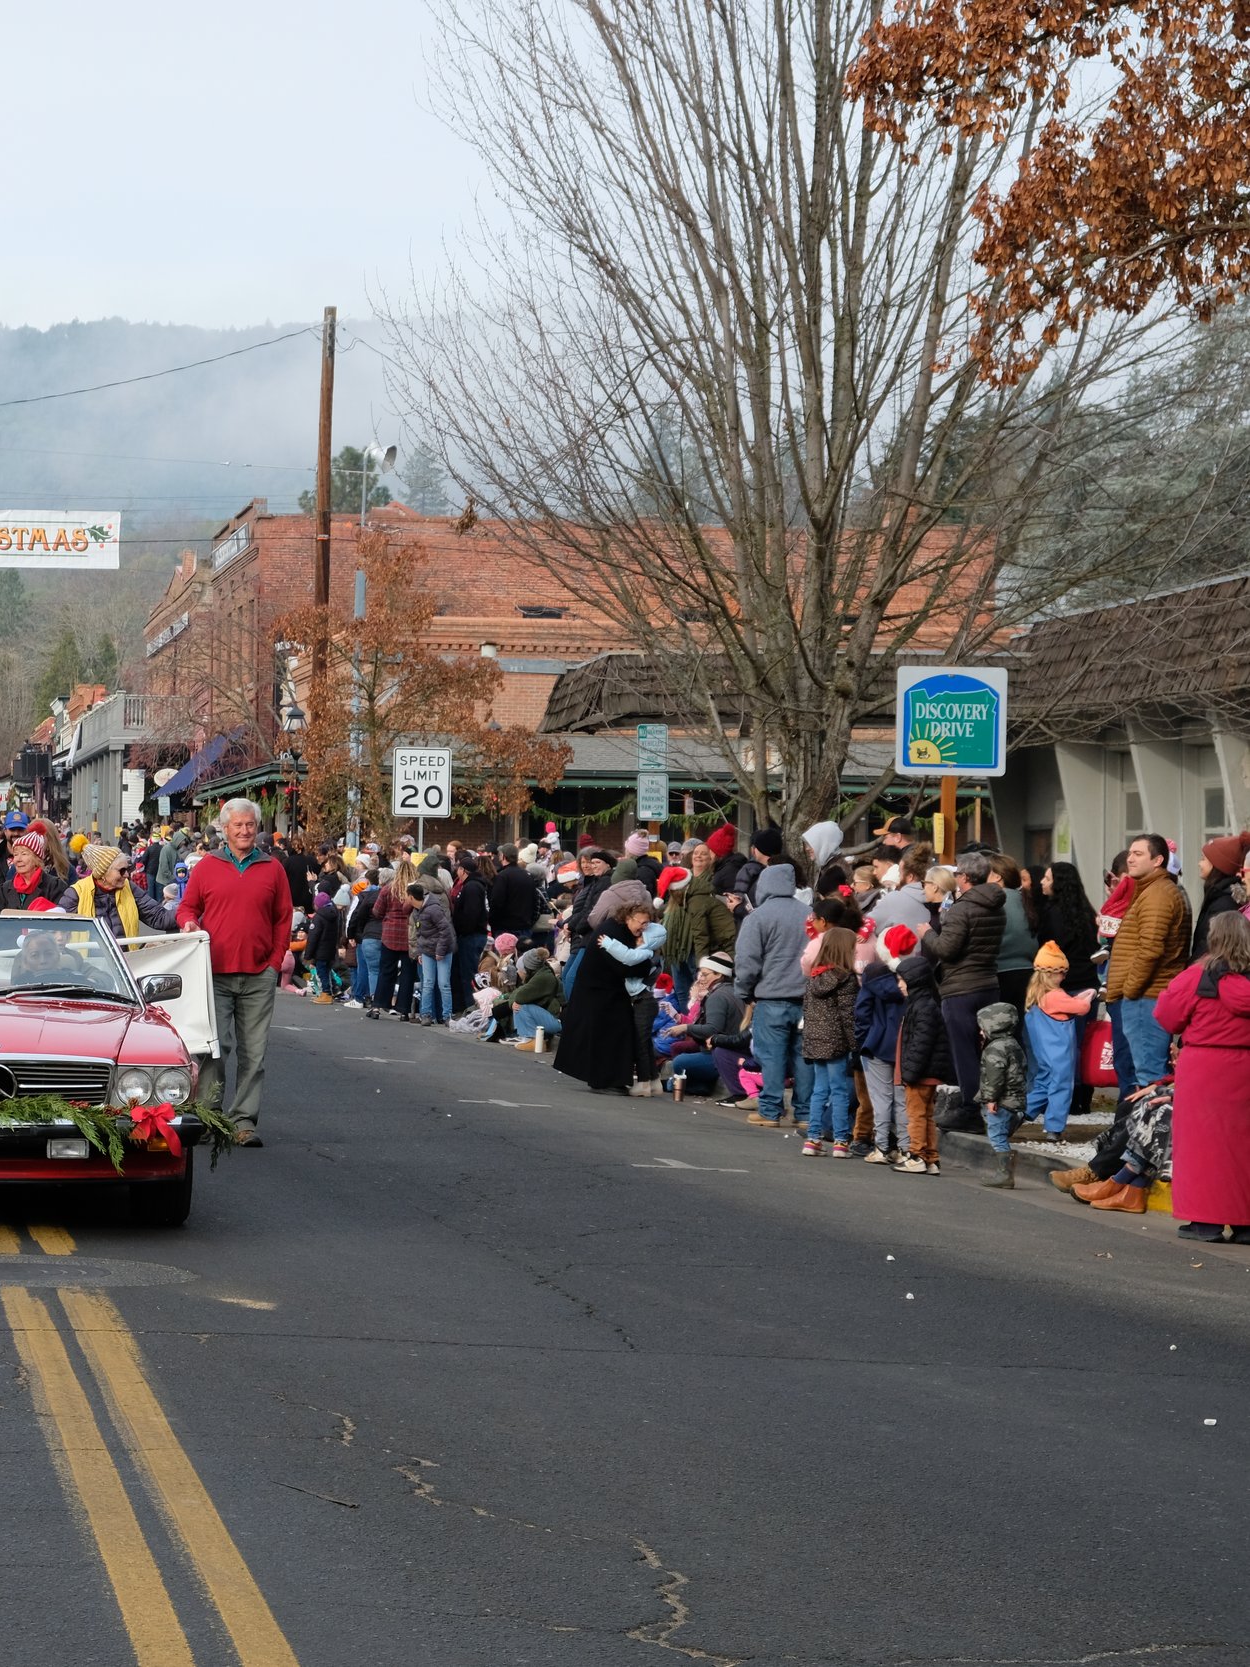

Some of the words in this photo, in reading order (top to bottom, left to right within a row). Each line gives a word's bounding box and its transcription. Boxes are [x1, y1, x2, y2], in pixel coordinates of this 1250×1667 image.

[915, 702, 989, 720] DISCOVERY
[930, 721, 975, 738] DRIVE
[399, 755, 446, 766] SPEED
[404, 770, 440, 780] LIMIT
[400, 785, 443, 808] 20
